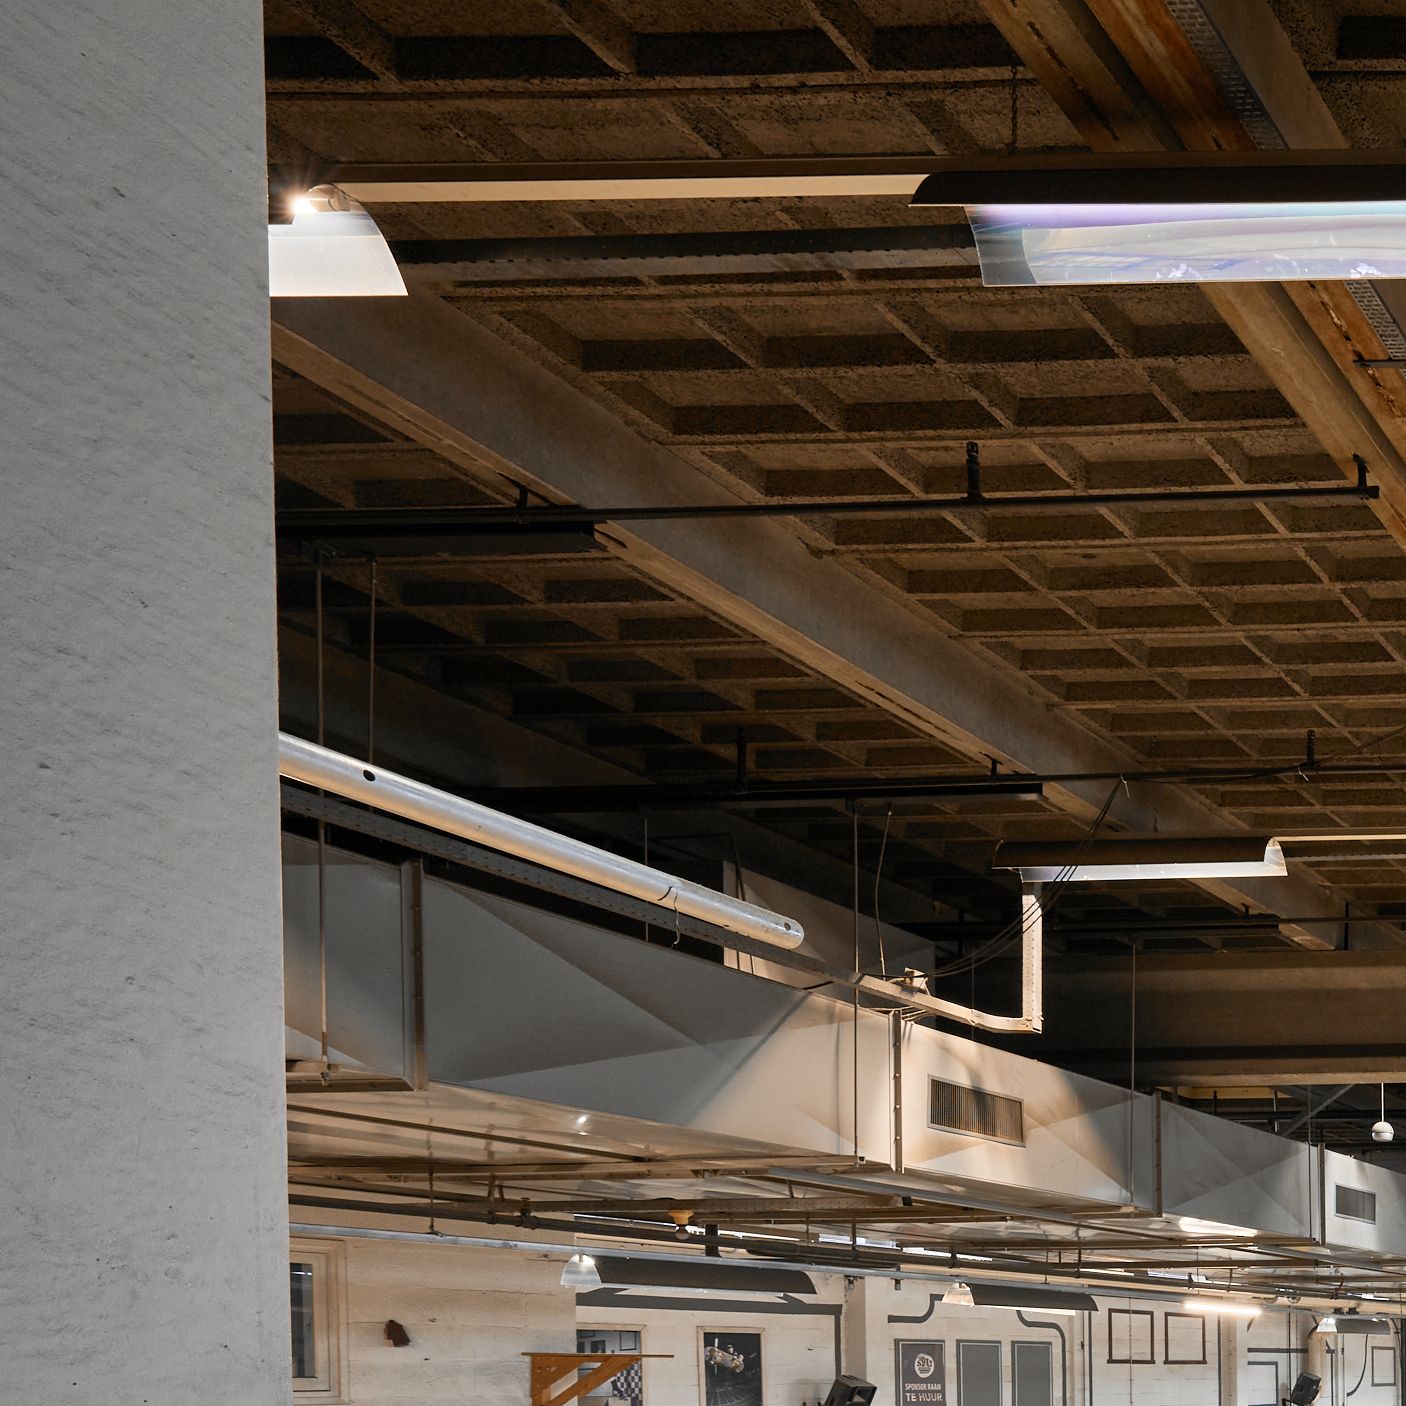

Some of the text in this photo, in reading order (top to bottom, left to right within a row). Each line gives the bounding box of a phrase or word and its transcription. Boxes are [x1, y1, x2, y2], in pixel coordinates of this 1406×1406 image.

[904, 1383, 926, 1391] SPONSOR
[905, 1393, 943, 1402] TE HUUR
